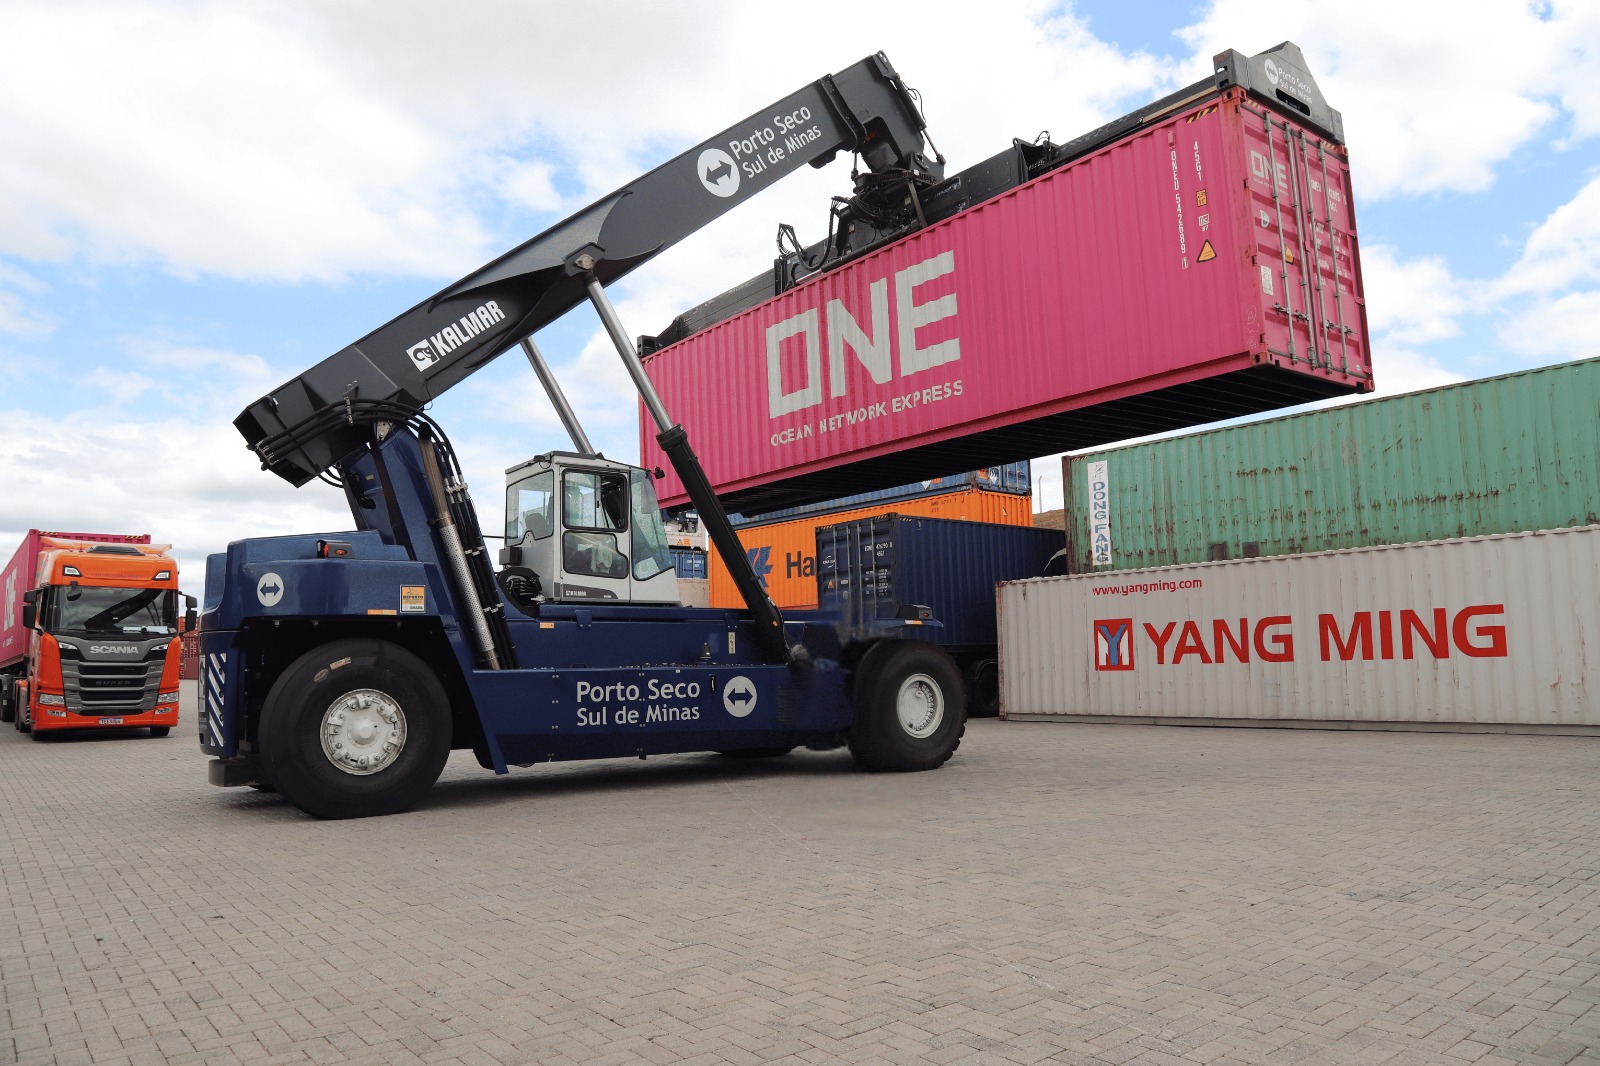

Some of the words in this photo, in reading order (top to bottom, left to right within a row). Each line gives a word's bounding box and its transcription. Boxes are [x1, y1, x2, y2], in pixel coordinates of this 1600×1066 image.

[1278, 67, 1295, 85] Porto
[1296, 78, 1312, 94] Seco
[1279, 78, 1289, 90] Sul
[1290, 86, 1297, 95] de
[1297, 88, 1313, 104] Minas
[729, 127, 775, 160] Porto
[773, 106, 811, 135] Seco
[742, 153, 768, 178] Sul
[767, 146, 785, 164] de
[784, 125, 822, 154] Minas
[1250, 150, 1288, 189] ONE
[1170, 150, 1180, 191] ONEU
[1175, 192, 1187, 254] 542689
[430, 300, 506, 357] KALMAR
[765, 249, 961, 419] ONE
[770, 424, 813, 447] OCEAN
[819, 402, 887, 435] NETWORK
[892, 379, 964, 413] EXPRESS
[786, 551, 817, 582] Ha
[1092, 579, 1203, 596] www.yangming.com
[90, 645, 139, 654] SCANIA
[1142, 615, 1294, 664] YANG
[1318, 603, 1508, 661] MING
[576, 681, 640, 703] Porto
[647, 679, 700, 700] Seco
[576, 707, 608, 726] Sul
[614, 705, 640, 724] de
[645, 703, 700, 723] Minas
